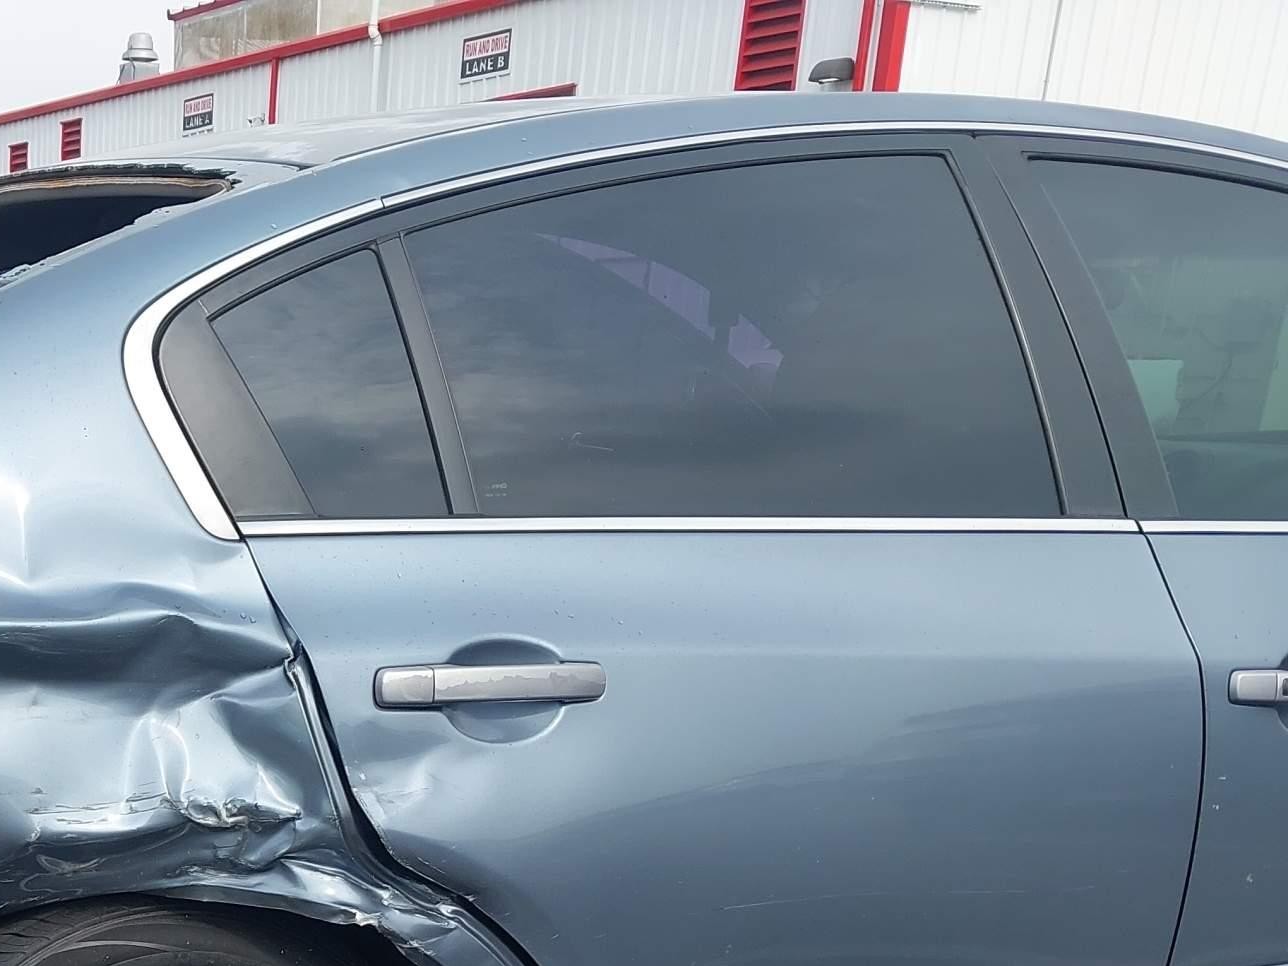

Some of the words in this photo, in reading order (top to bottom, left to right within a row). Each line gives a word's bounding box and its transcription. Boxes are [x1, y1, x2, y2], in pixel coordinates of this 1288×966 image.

[465, 42, 478, 58] RUN
[478, 38, 491, 55] AND
[491, 34, 509, 52] DRIVE
[465, 57, 494, 75] LANE
[497, 55, 505, 70] B
[185, 114, 203, 128] LANE
